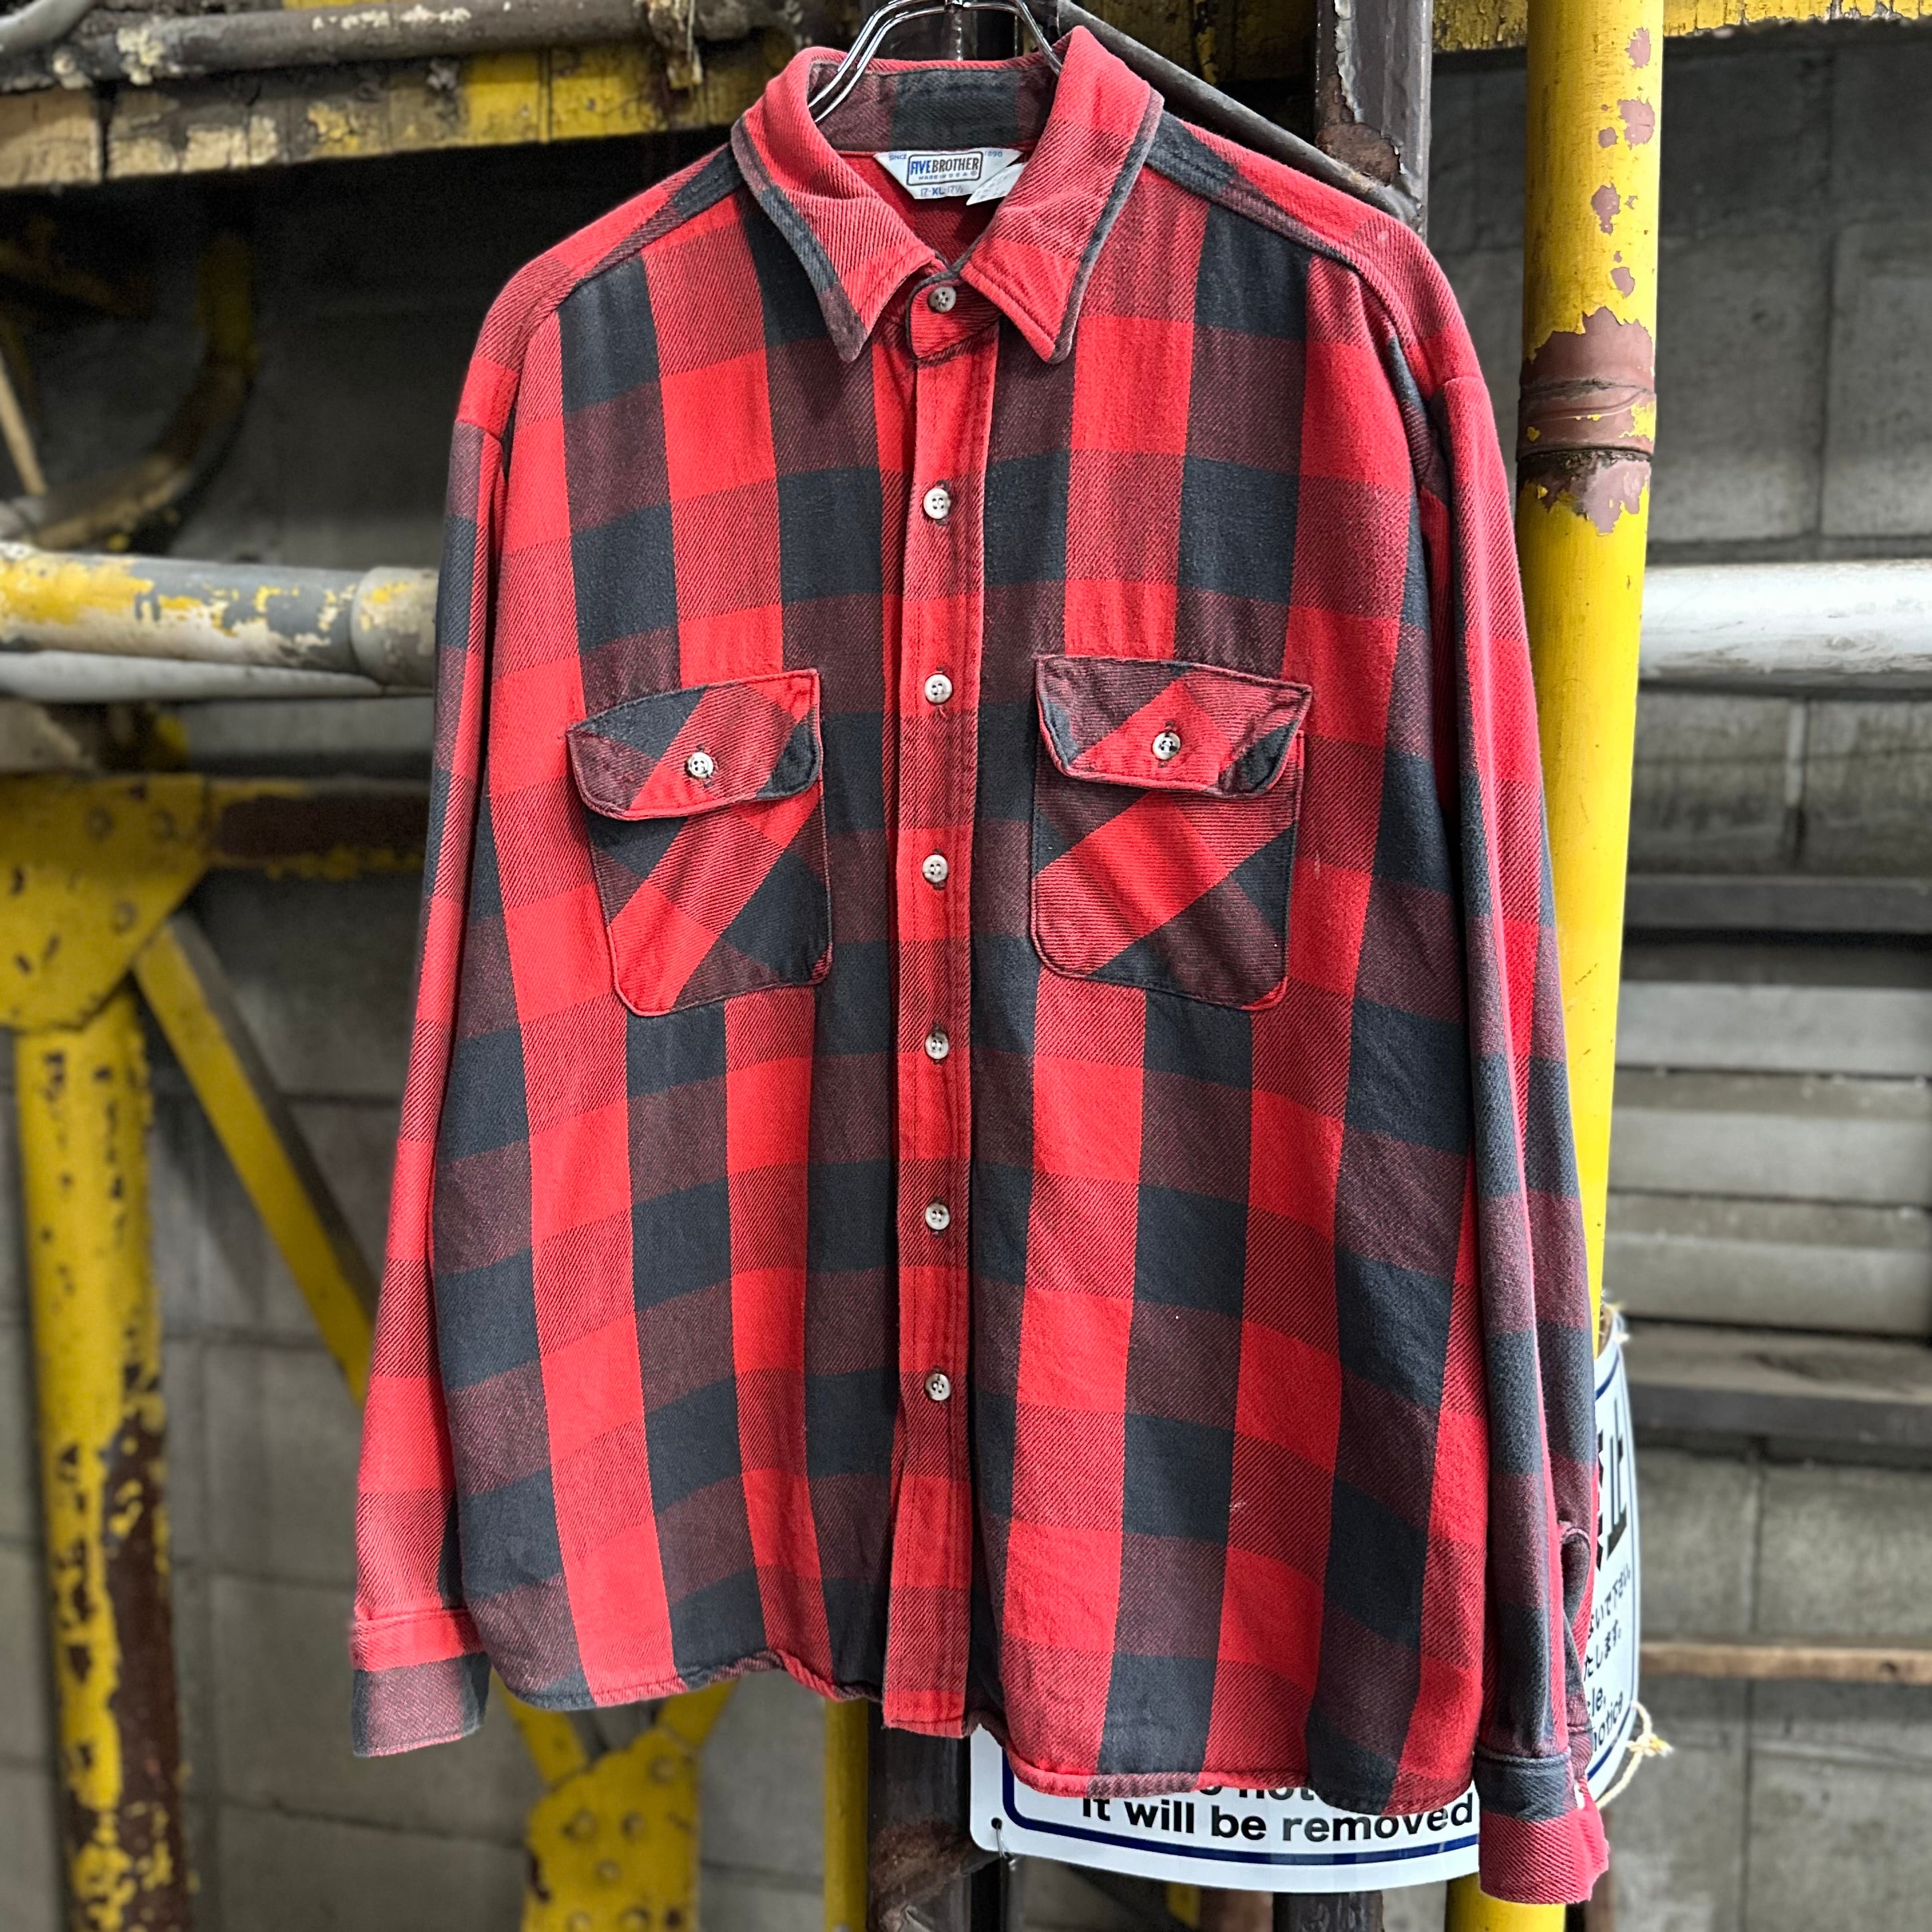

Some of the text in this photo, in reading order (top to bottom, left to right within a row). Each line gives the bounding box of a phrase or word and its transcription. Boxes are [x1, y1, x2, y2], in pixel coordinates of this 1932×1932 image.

[1124, 1799, 1195, 1834] will
[1211, 1804, 1267, 1840] be
[1282, 1792, 1473, 1842] removed
